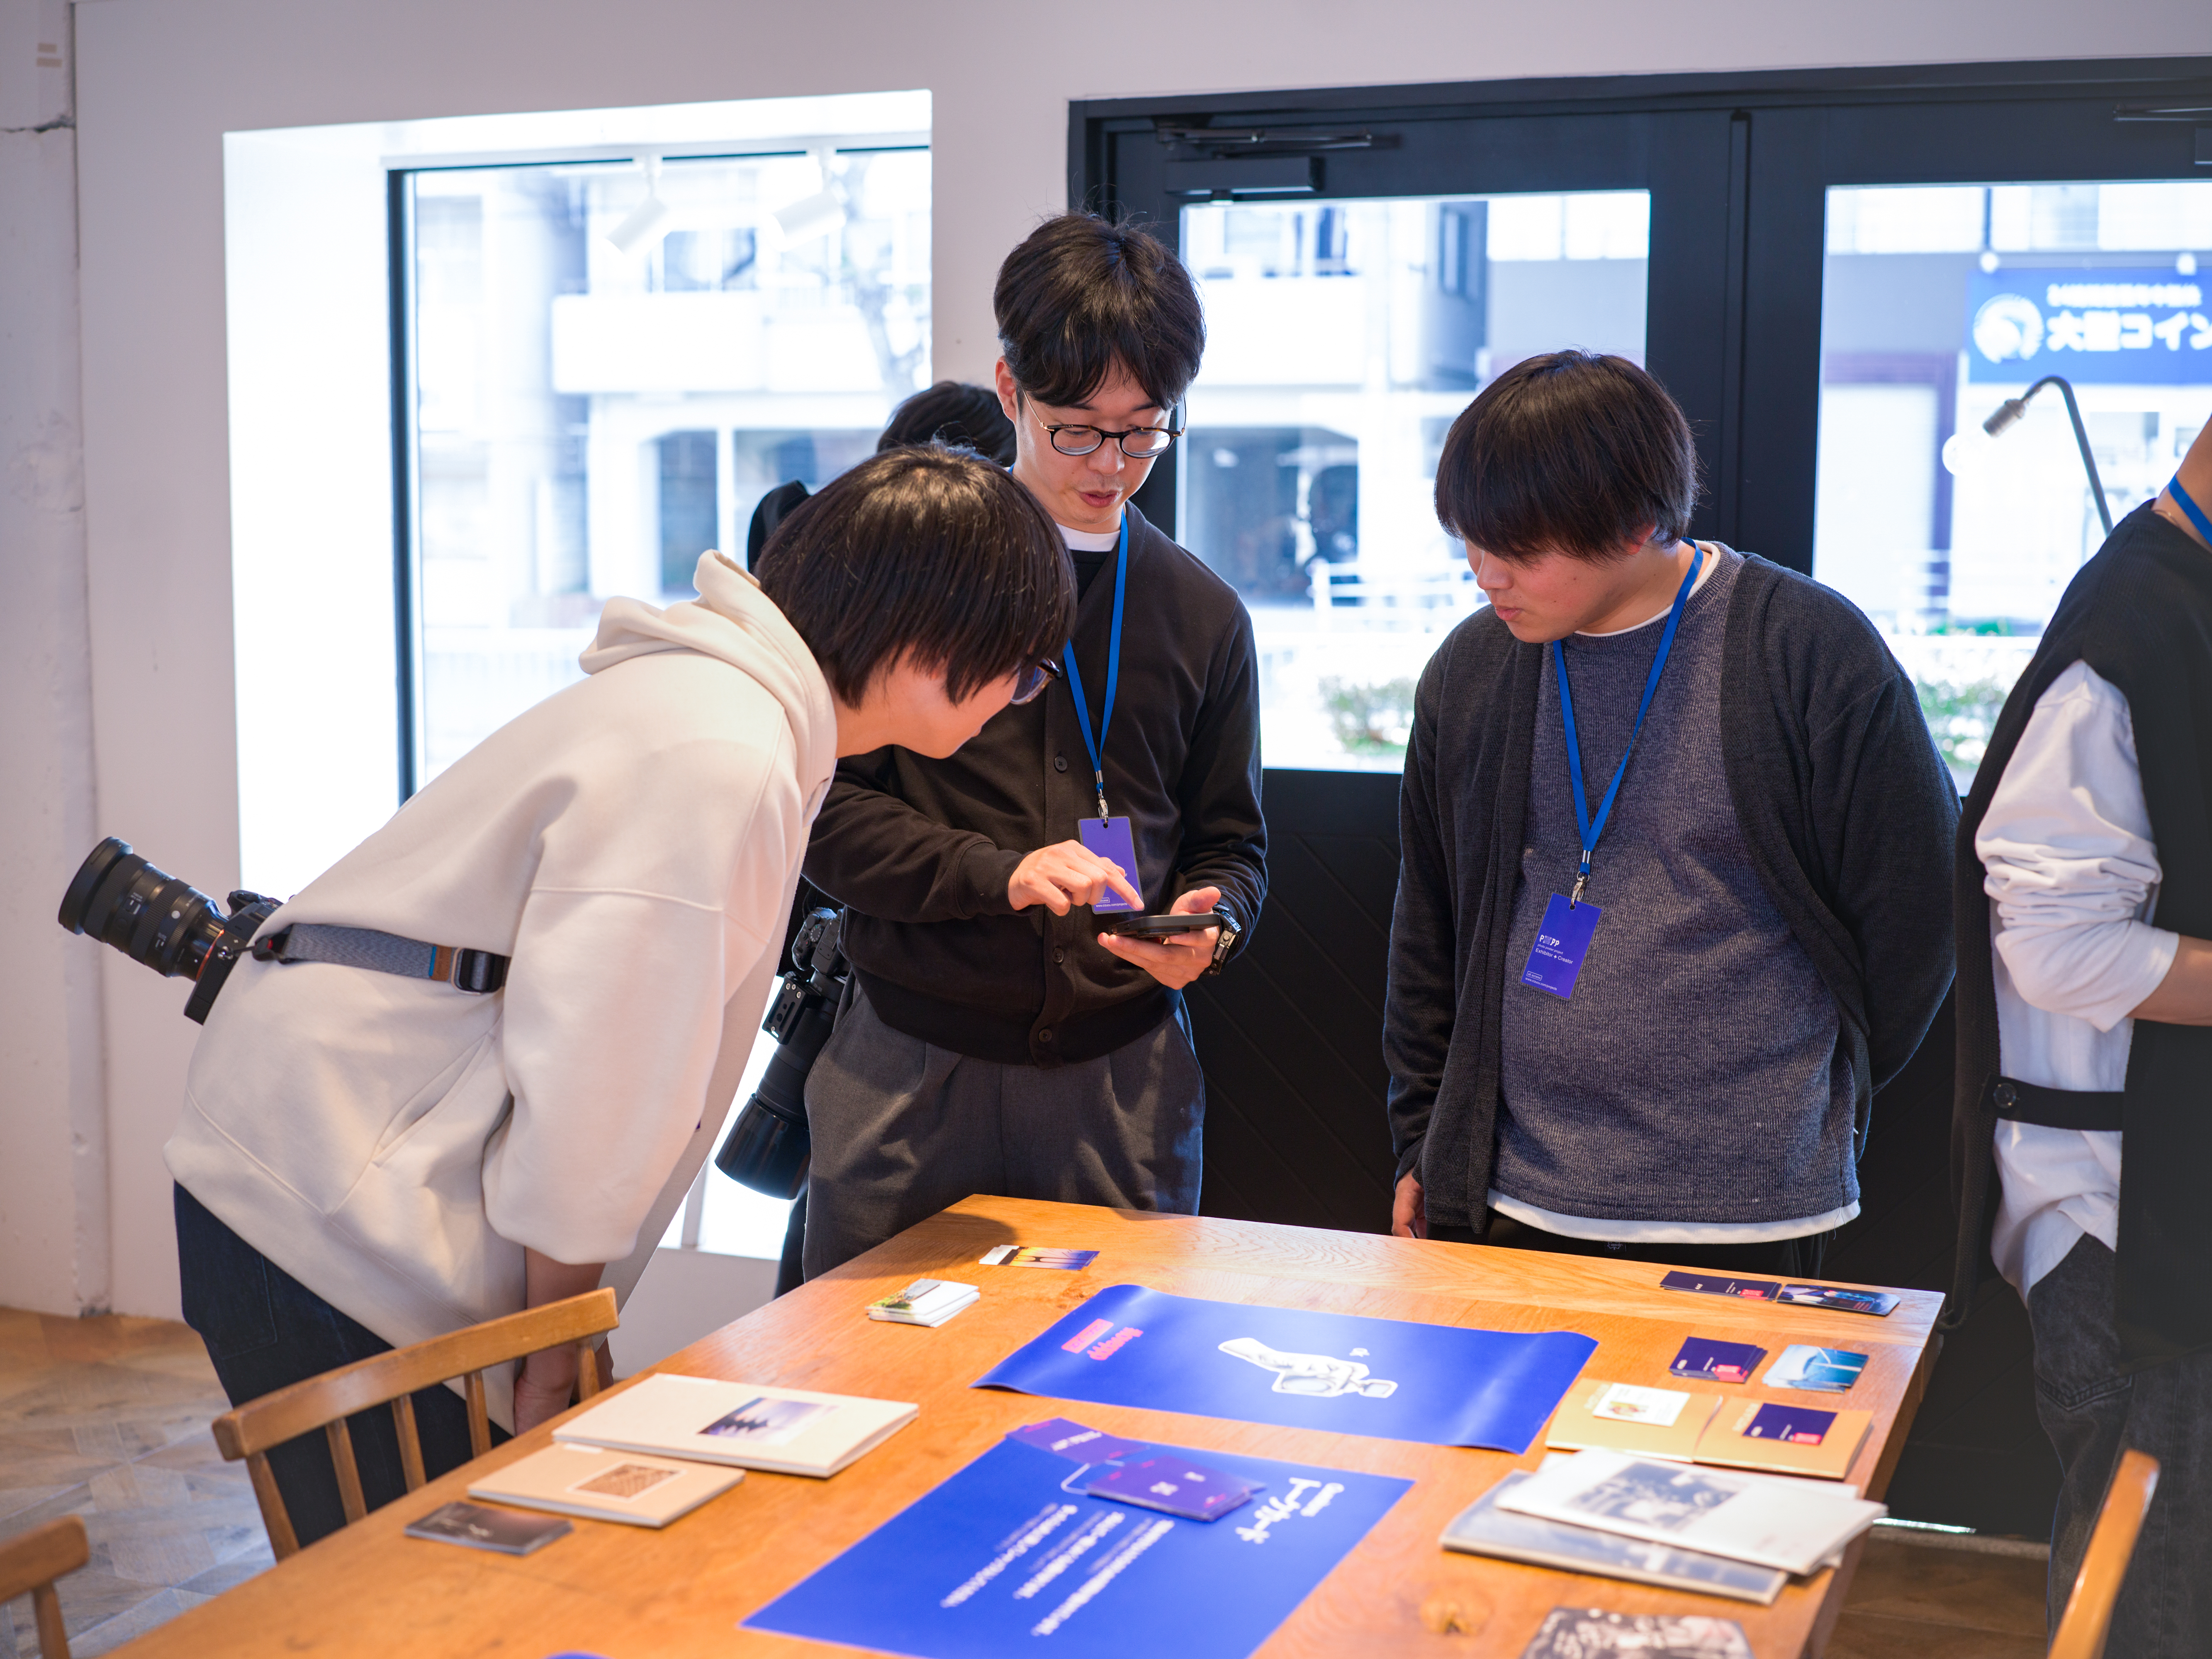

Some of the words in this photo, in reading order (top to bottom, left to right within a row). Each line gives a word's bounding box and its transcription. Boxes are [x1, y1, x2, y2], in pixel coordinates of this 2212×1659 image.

[2047, 309, 2212, 352] 大コイン
[1535, 948, 1553, 957] Exhibitor
[1557, 956, 1573, 964] Creator
[1525, 977, 1557, 990] www.cizucu.com/projects
